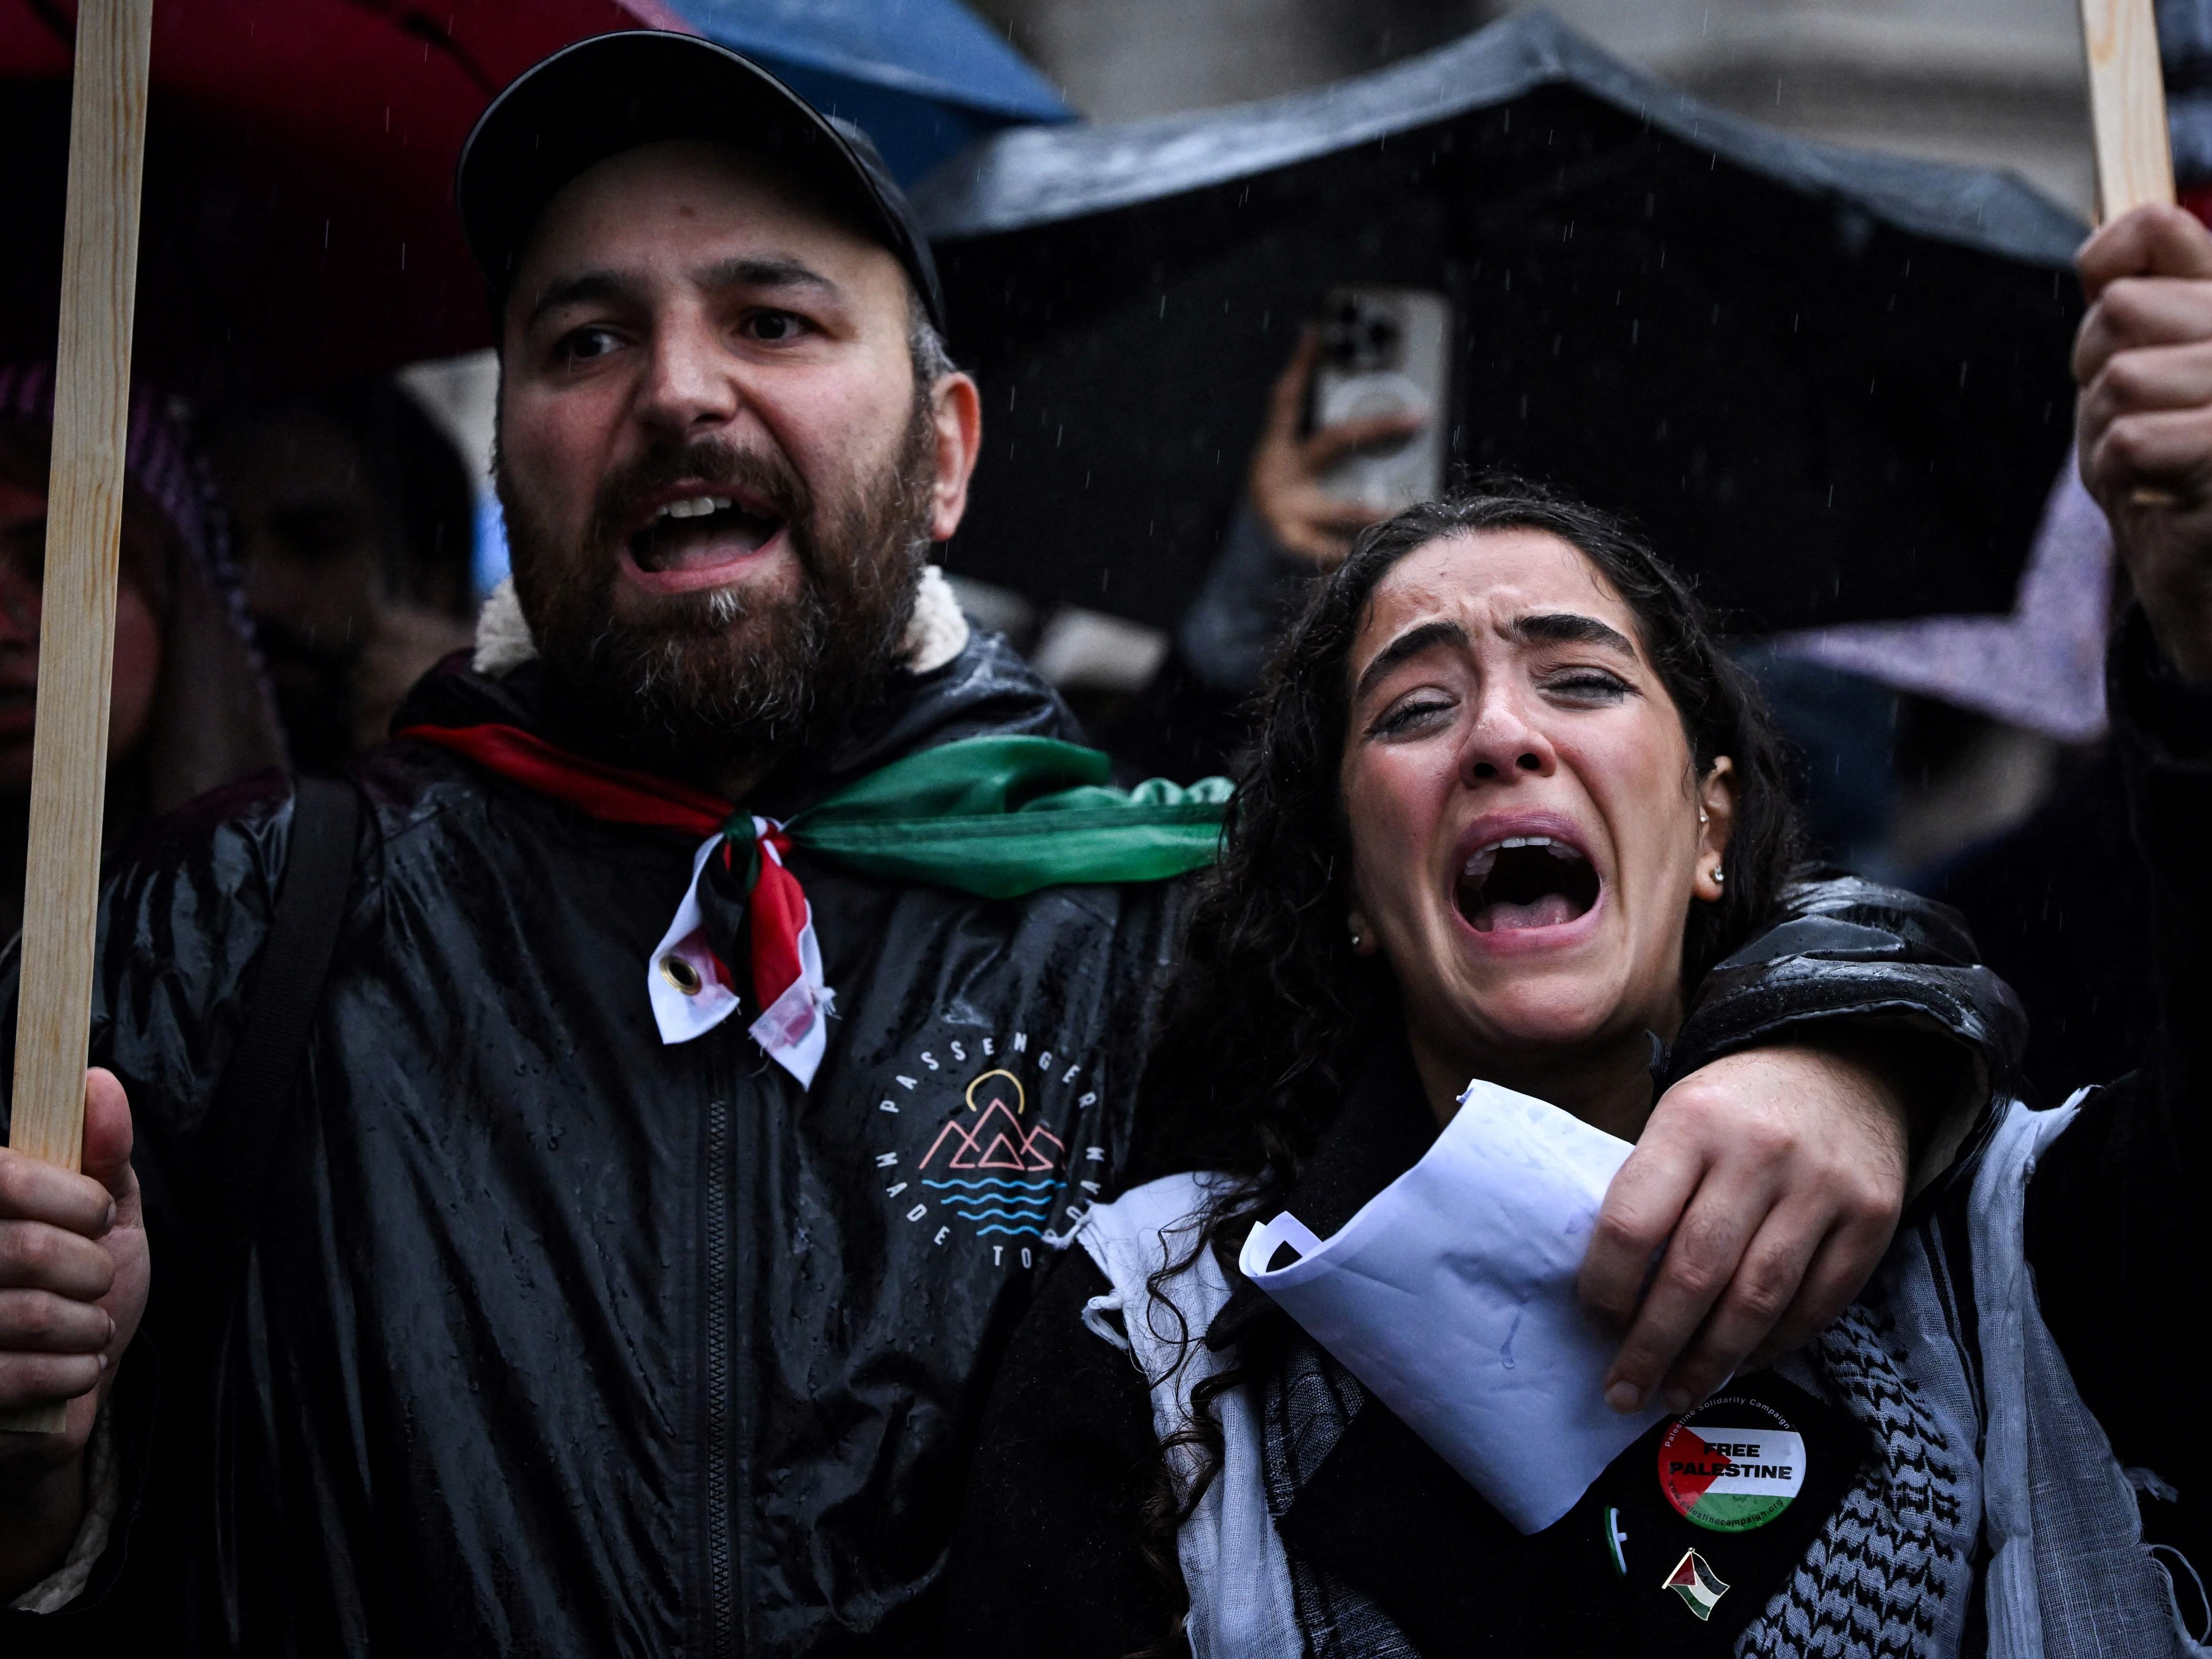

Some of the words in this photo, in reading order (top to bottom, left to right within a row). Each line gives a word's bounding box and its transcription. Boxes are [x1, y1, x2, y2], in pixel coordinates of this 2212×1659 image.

[879, 1032, 1097, 1113] PASSENGER
[875, 1152, 950, 1245] MADE
[992, 1245, 1032, 1269] TO
[1664, 1410, 1695, 1447] Palestine
[1749, 1399, 1790, 1429] Campaign
[1669, 1461, 1793, 1480] PALESTINE
[1704, 1442, 1761, 1458] FREE
